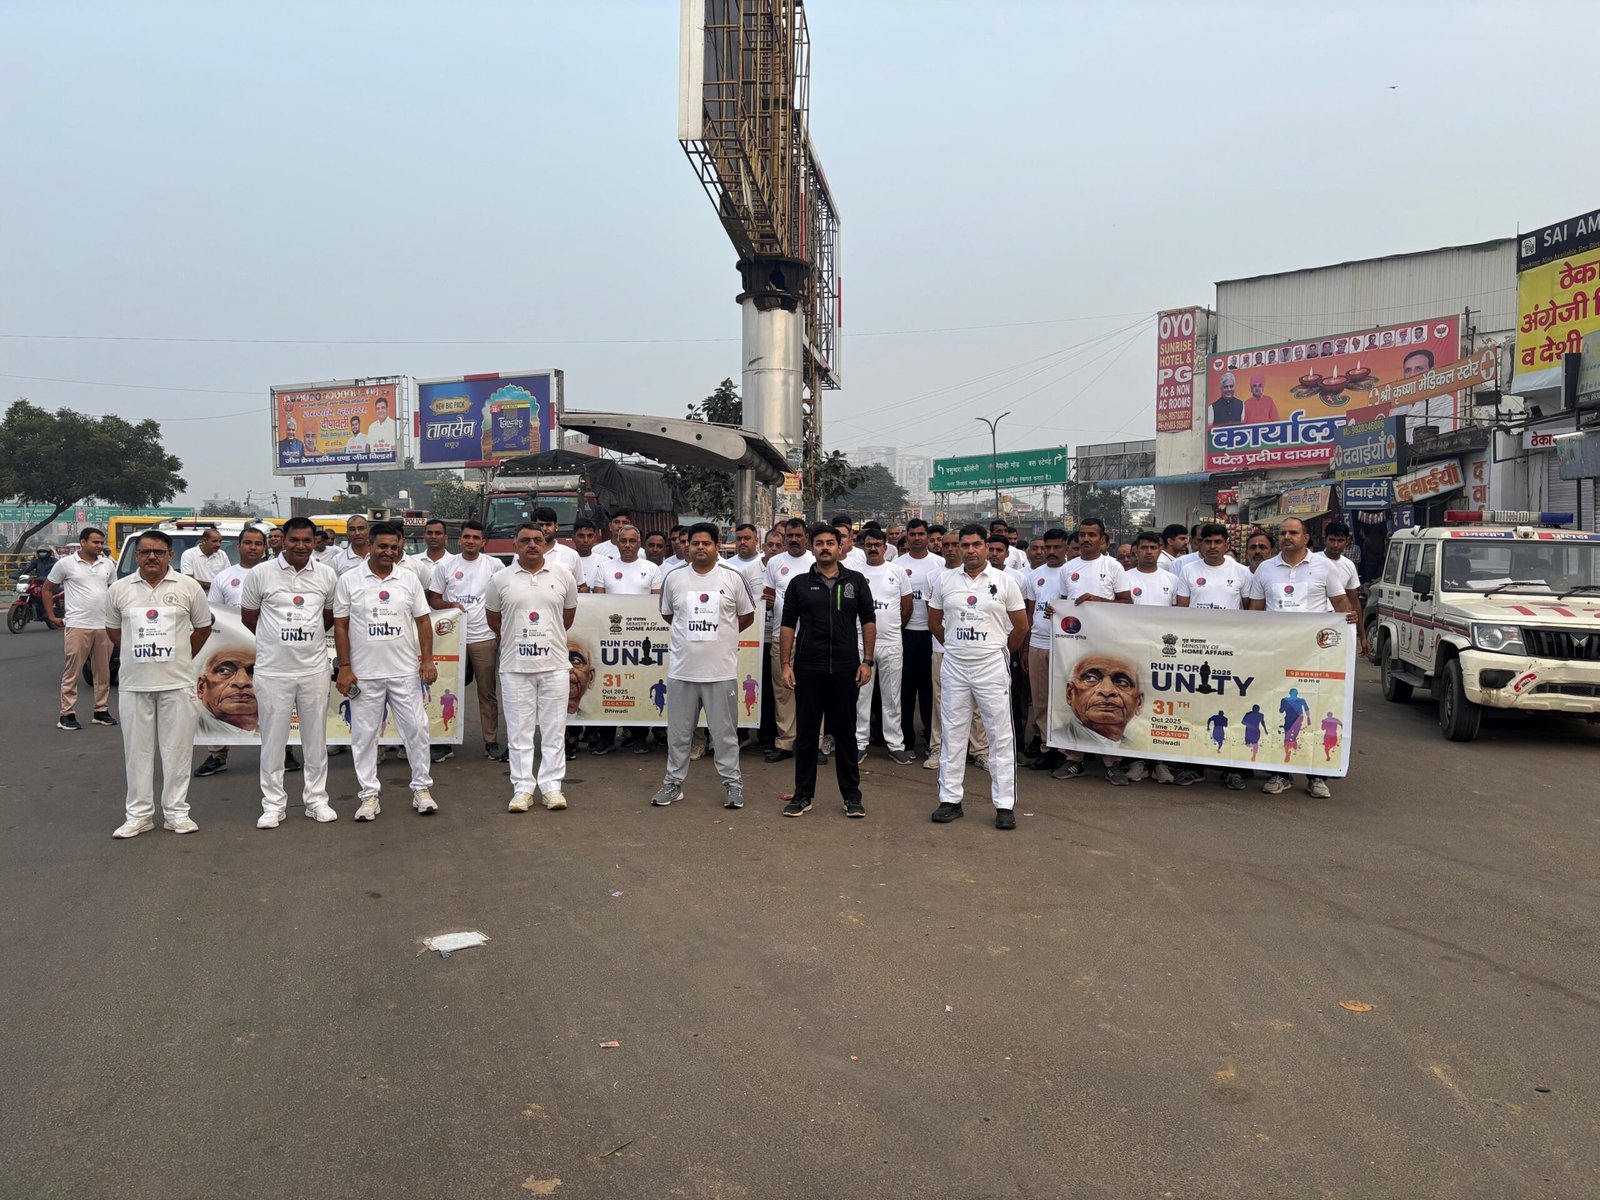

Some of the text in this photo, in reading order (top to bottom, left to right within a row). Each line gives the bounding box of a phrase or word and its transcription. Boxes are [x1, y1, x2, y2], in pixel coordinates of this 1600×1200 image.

[1543, 224, 1567, 247] SAI
[1520, 291, 1589, 333] अंग्रेजी
[1160, 313, 1193, 339] OYO
[1160, 340, 1192, 354] SUNRISE
[1160, 353, 1191, 367] HOTEL &
[1521, 346, 1537, 366] व
[1158, 366, 1193, 385] PG
[1393, 381, 1417, 403] कृष्णा
[1418, 367, 1454, 391] मेडिकल
[1457, 359, 1479, 381] स्टोर
[1160, 384, 1190, 398] AC & NON
[1158, 398, 1191, 410] AC ROOMS
[427, 417, 475, 439] तानसेन
[1211, 410, 1346, 450] कार्याल
[1212, 448, 1331, 465] पटेल प्रदीप दायमा
[1346, 481, 1389, 499] दवाईयाँ
[281, 632, 315, 641] UNITY
[368, 626, 401, 636] UNITY
[956, 631, 988, 640] UNITY
[134, 647, 172, 657] UNITY
[519, 647, 550, 656] UNITY
[601, 648, 671, 666] UNIT
[1205, 649, 1234, 657] AFFAIRS
[1151, 663, 1174, 671] RUN
[1177, 664, 1200, 672] FOR
[603, 674, 621, 687] 31
[1152, 671, 1255, 697] UNITY
[1153, 700, 1174, 716] 31
[1152, 738, 1180, 746] Bhiwadi
